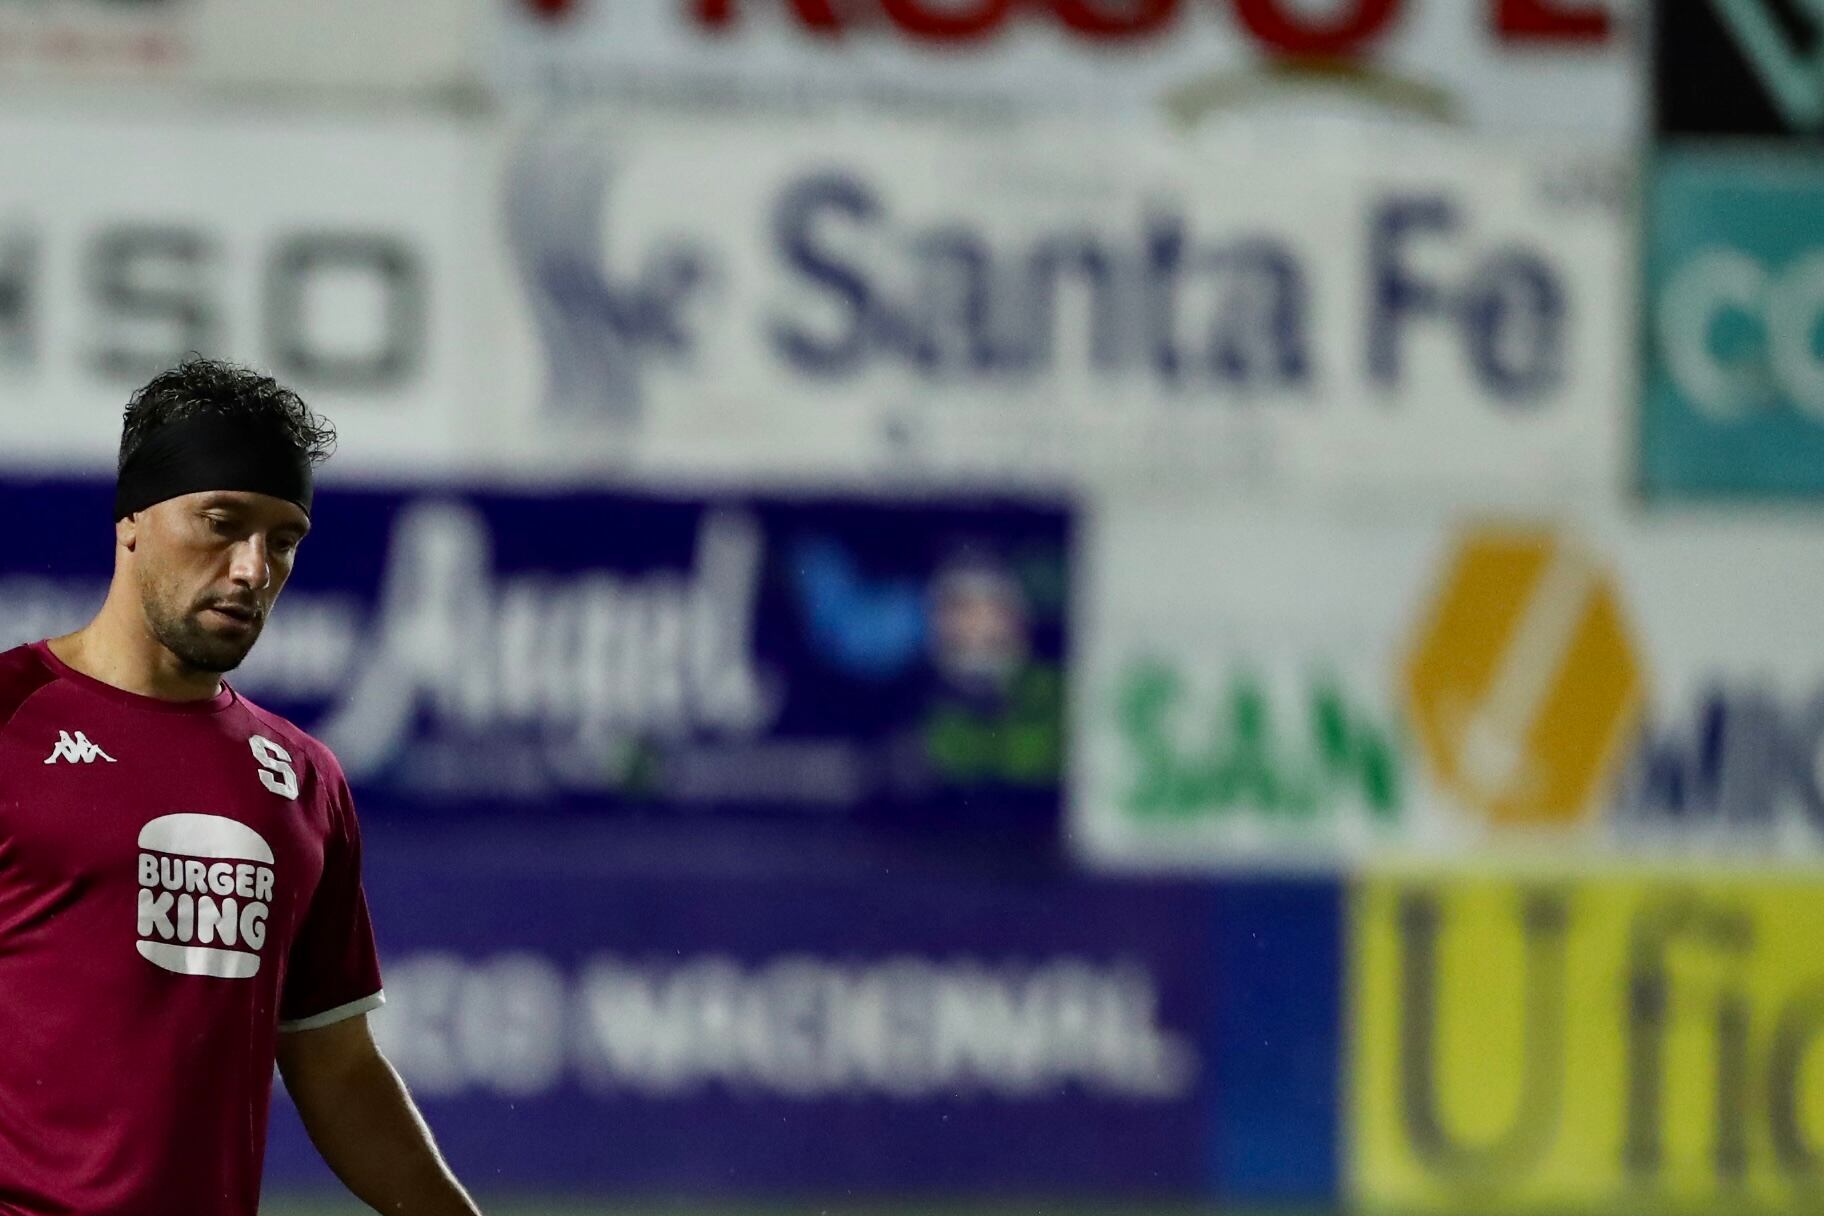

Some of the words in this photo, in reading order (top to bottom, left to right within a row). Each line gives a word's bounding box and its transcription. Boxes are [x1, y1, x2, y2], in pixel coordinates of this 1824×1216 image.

[768, 170, 1312, 390] Santa
[1366, 188, 1568, 408] Fe
[1109, 660, 1402, 822] SAN
[137, 888, 269, 951] KING
[138, 853, 275, 902] BURGER
